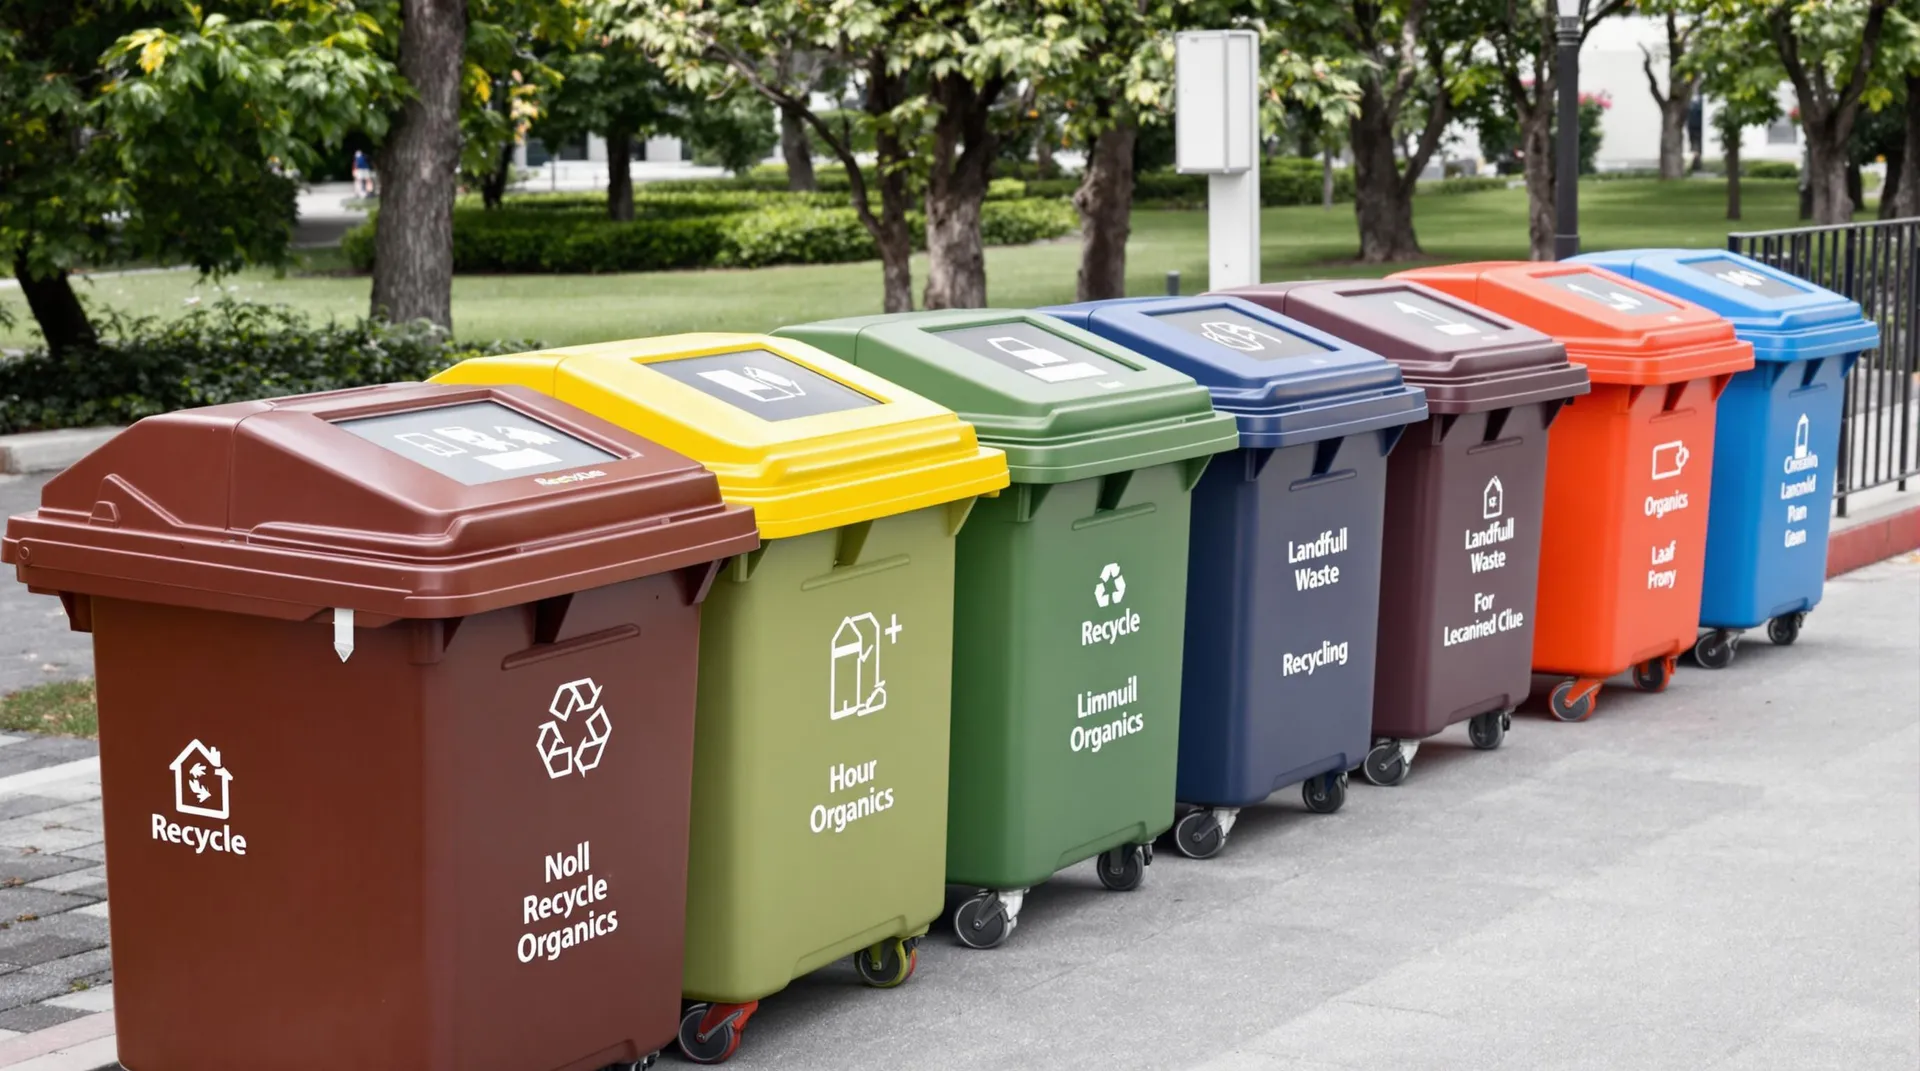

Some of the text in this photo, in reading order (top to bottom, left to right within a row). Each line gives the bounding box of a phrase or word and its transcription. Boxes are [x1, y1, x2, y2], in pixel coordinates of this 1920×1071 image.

[1645, 490, 1688, 518] Organics
[1289, 527, 1348, 563] Landfull
[1471, 551, 1506, 573] Waste
[1295, 565, 1340, 591] Waste
[1475, 593, 1494, 613] For
[1082, 608, 1140, 645] Recycle
[1283, 640, 1348, 676] Recycling
[1078, 675, 1137, 718] Limnuil
[1070, 712, 1143, 752] Organics
[830, 760, 877, 793] Hour
[810, 787, 894, 833] Organics
[152, 813, 247, 855] Recycle
[545, 841, 590, 883] Noll
[523, 874, 608, 924] Recycle
[517, 910, 618, 963] Organics
